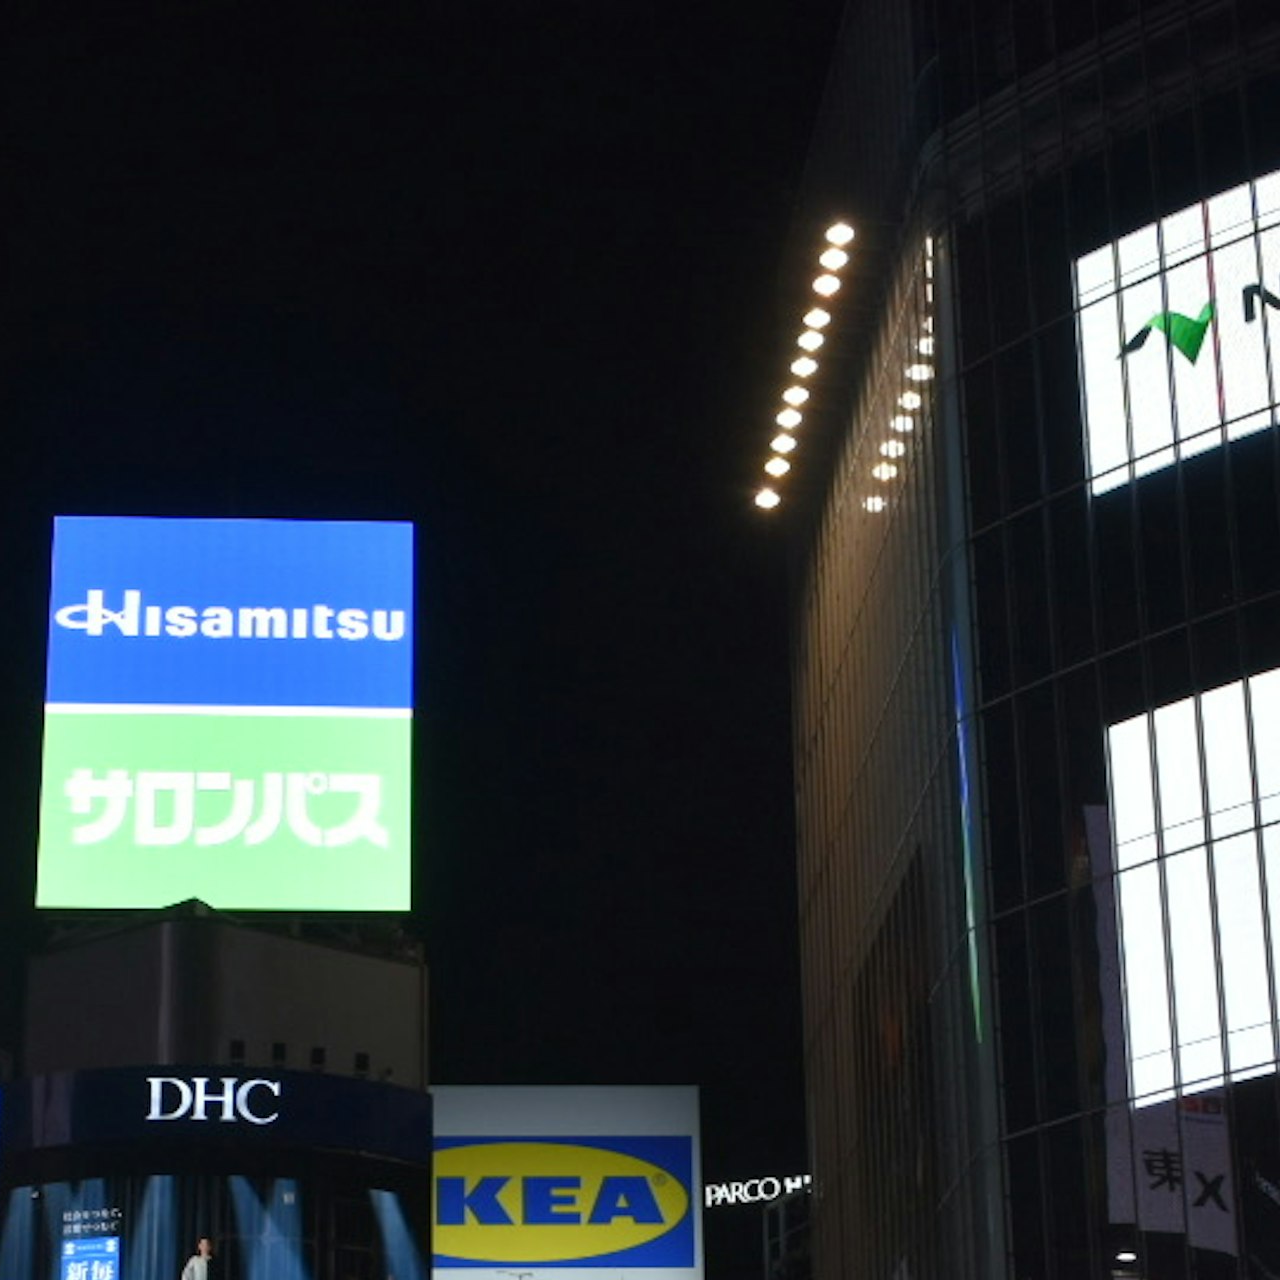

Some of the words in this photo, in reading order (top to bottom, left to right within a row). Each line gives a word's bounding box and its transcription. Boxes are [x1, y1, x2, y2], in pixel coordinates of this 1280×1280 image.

[56, 589, 406, 640] Hisamitsu
[64, 768, 390, 849] サロンパス
[146, 1077, 281, 1124] DHC
[436, 1177, 665, 1225] KEA
[705, 1177, 782, 1209] PARCO
